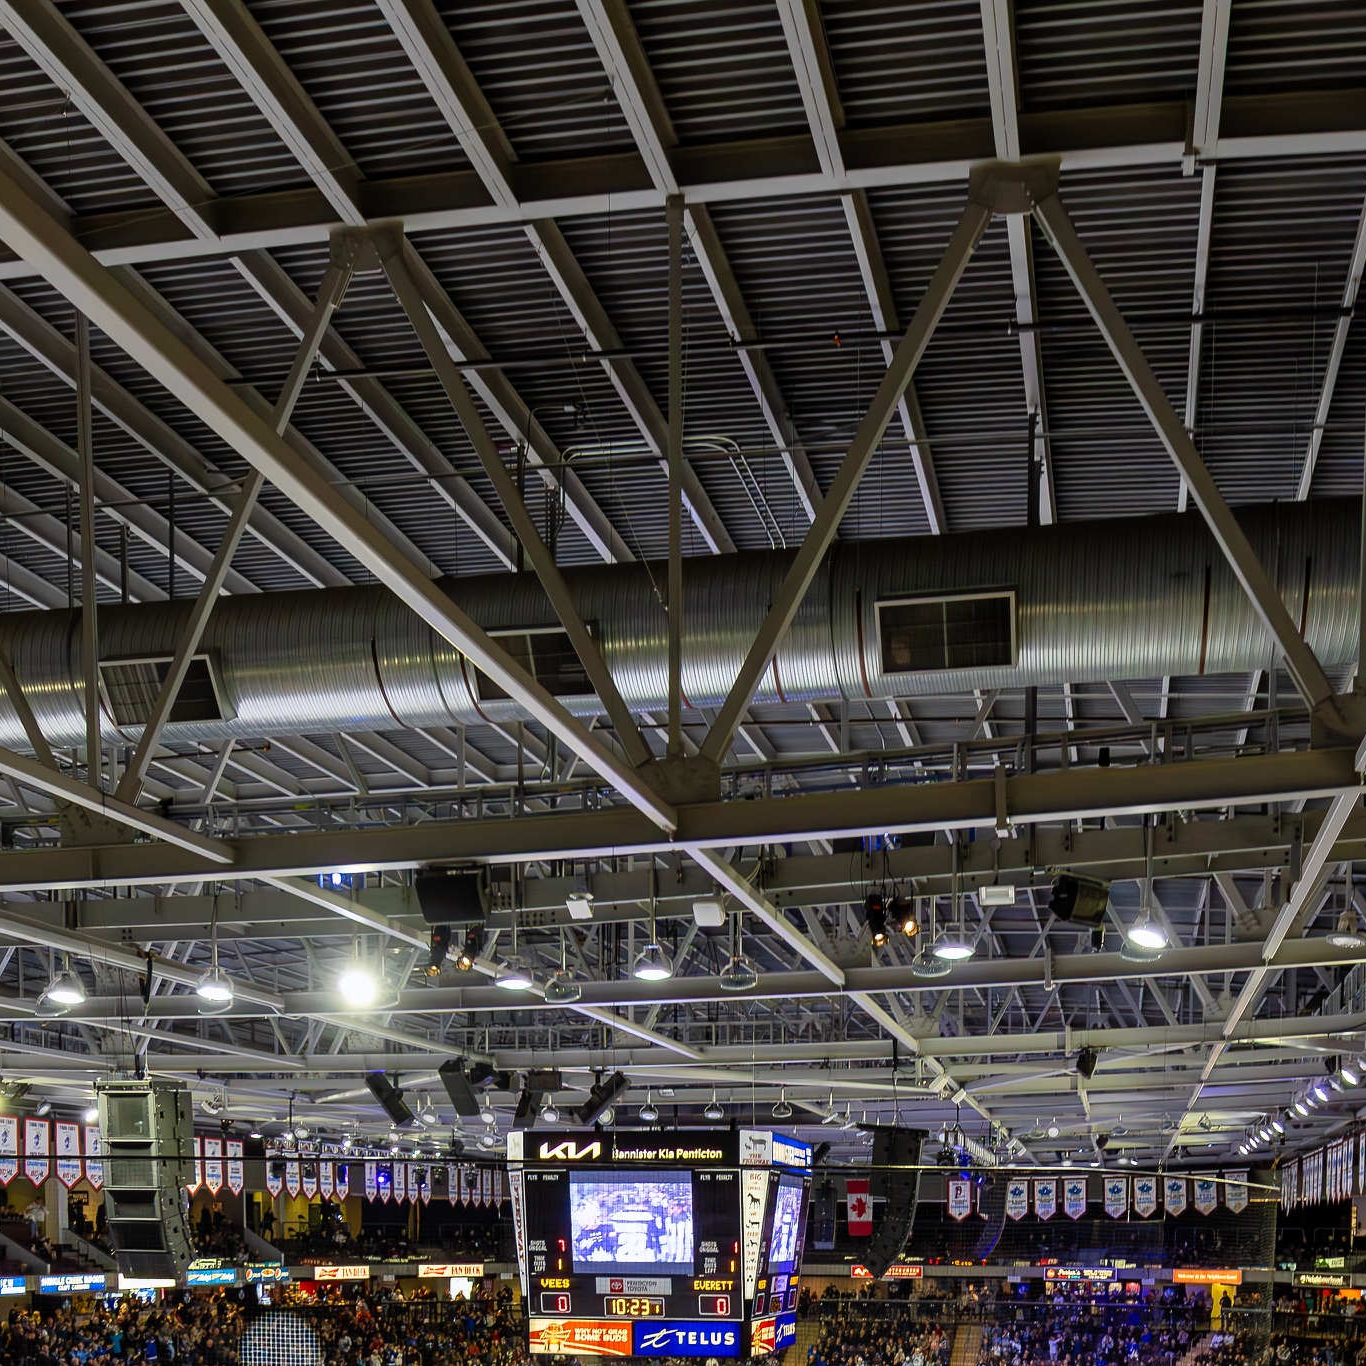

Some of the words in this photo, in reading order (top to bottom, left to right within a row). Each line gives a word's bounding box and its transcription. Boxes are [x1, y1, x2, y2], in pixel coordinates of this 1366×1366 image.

[613, 1149, 657, 1160] Bannister
[659, 1149, 674, 1159] Kia
[676, 1148, 723, 1159] Penticton
[541, 1278, 570, 1289] VEES
[693, 1280, 734, 1291] EVERETT
[558, 1296, 567, 1312] 0
[612, 1299, 650, 1315] 10:23
[717, 1298, 726, 1315] 0
[575, 1334, 600, 1342] SOME
[676, 1331, 734, 1345] TELUS
